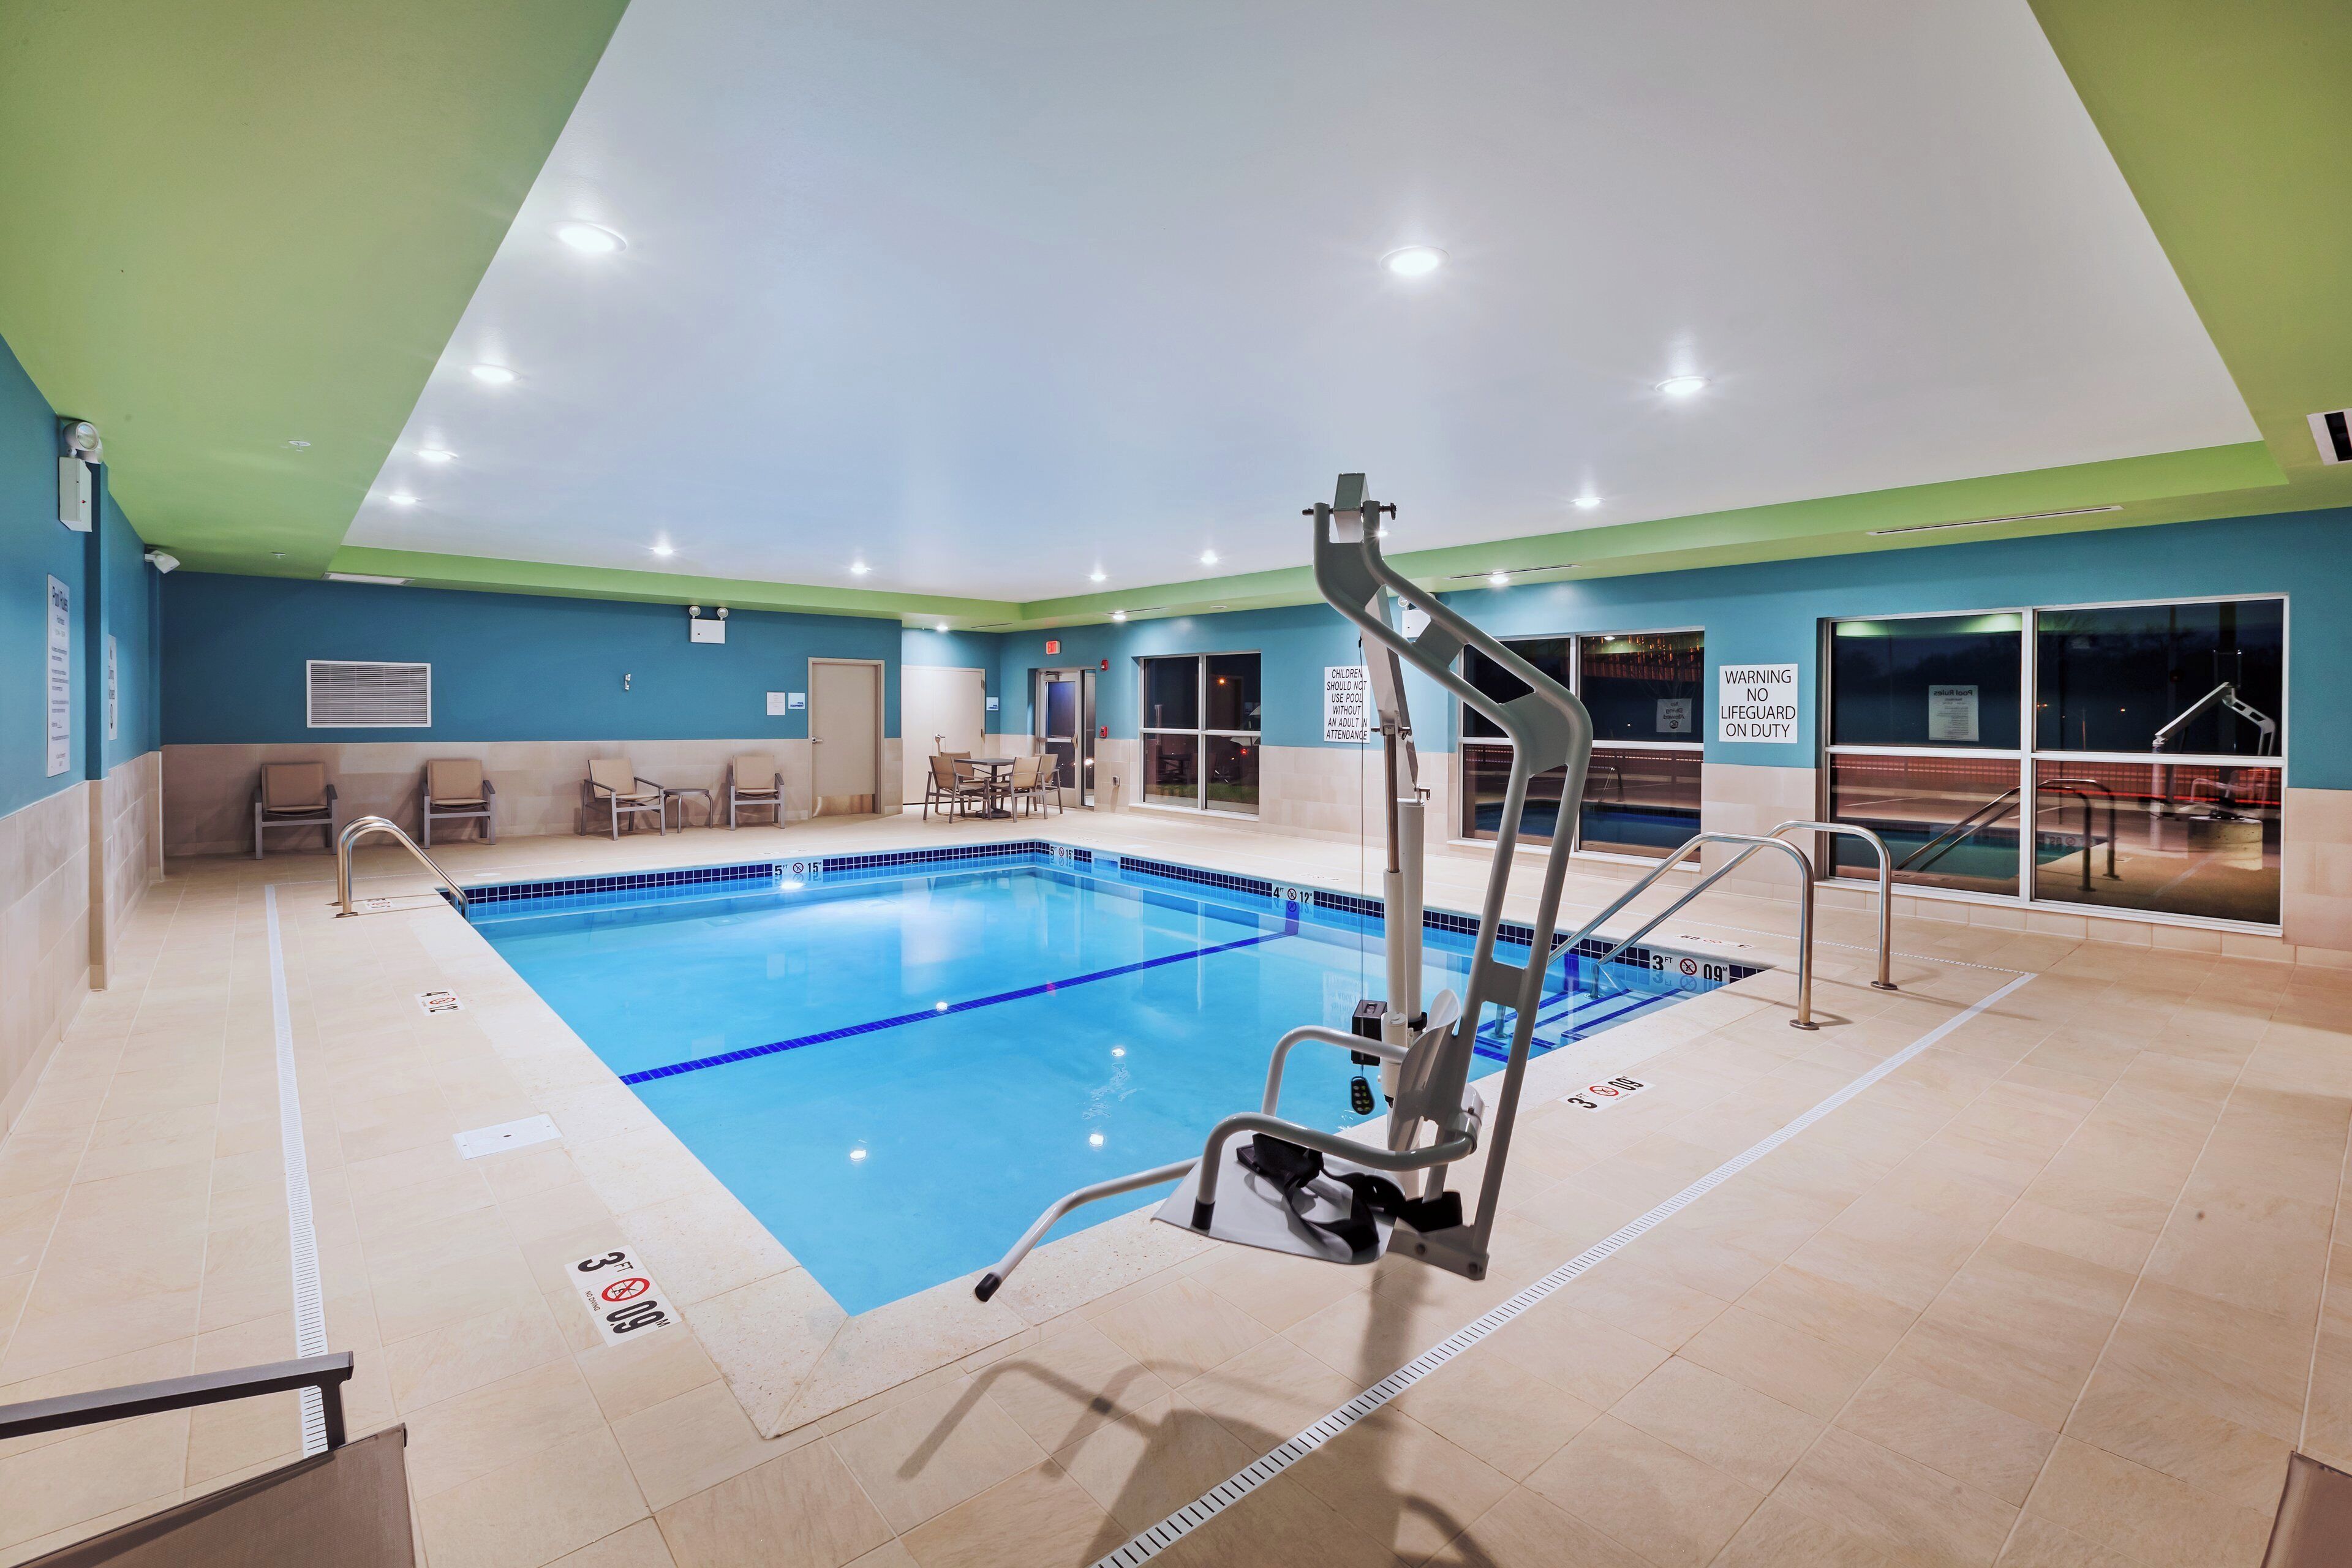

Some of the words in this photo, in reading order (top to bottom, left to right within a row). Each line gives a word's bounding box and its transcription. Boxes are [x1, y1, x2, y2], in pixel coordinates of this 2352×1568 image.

[1332, 668, 1362, 679] CHILDREN
[1725, 669, 1792, 684] WARNING
[1327, 680, 1351, 691] SHOULD
[1354, 680, 1367, 690] NOT
[1332, 693, 1344, 703] USE
[1346, 693, 1362, 703] POOL
[1747, 688, 1768, 702] NO
[1333, 706, 1361, 715] WITHOUT
[1721, 706, 1796, 720] LIFEGUARD
[1328, 718, 1336, 727] AN
[1338, 718, 1359, 727] ADULT
[1326, 729, 1367, 740] ATTENDANCE
[1726, 723, 1746, 737] ON
[1752, 723, 1790, 737] DUTY
[1050, 846, 1054, 855] 5
[1066, 849, 1072, 859] 15
[774, 865, 783, 876] 5
[808, 862, 818, 872] 15
[1273, 887, 1280, 899] 4
[1300, 891, 1310, 903] 12
[1653, 955, 1664, 970] 3
[1567, 1098, 1597, 1109] 3
[578, 1251, 625, 1272] 3
[614, 1261, 634, 1272] FT
[655, 1318, 671, 1328] M
[589, 1297, 600, 1311] DIVING
